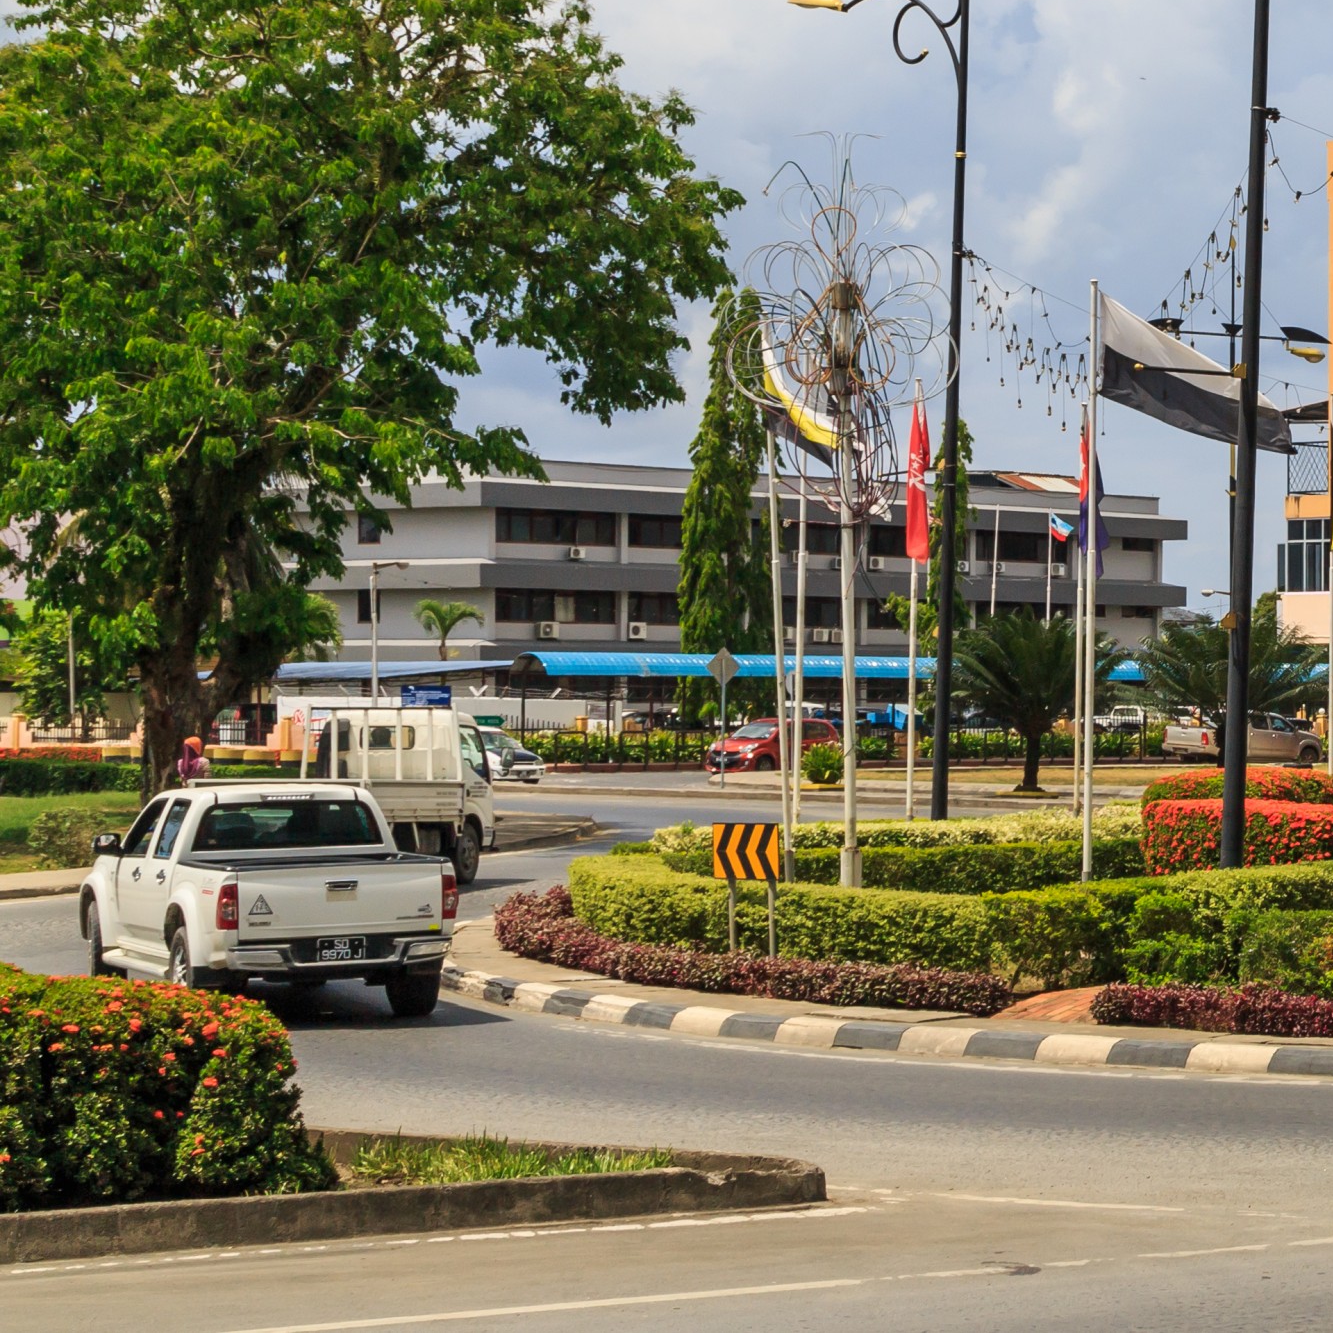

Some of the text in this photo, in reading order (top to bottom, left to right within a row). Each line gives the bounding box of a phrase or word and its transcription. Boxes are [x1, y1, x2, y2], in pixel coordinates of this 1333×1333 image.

[334, 939, 349, 949] SD
[321, 948, 362, 960] 9970 J
